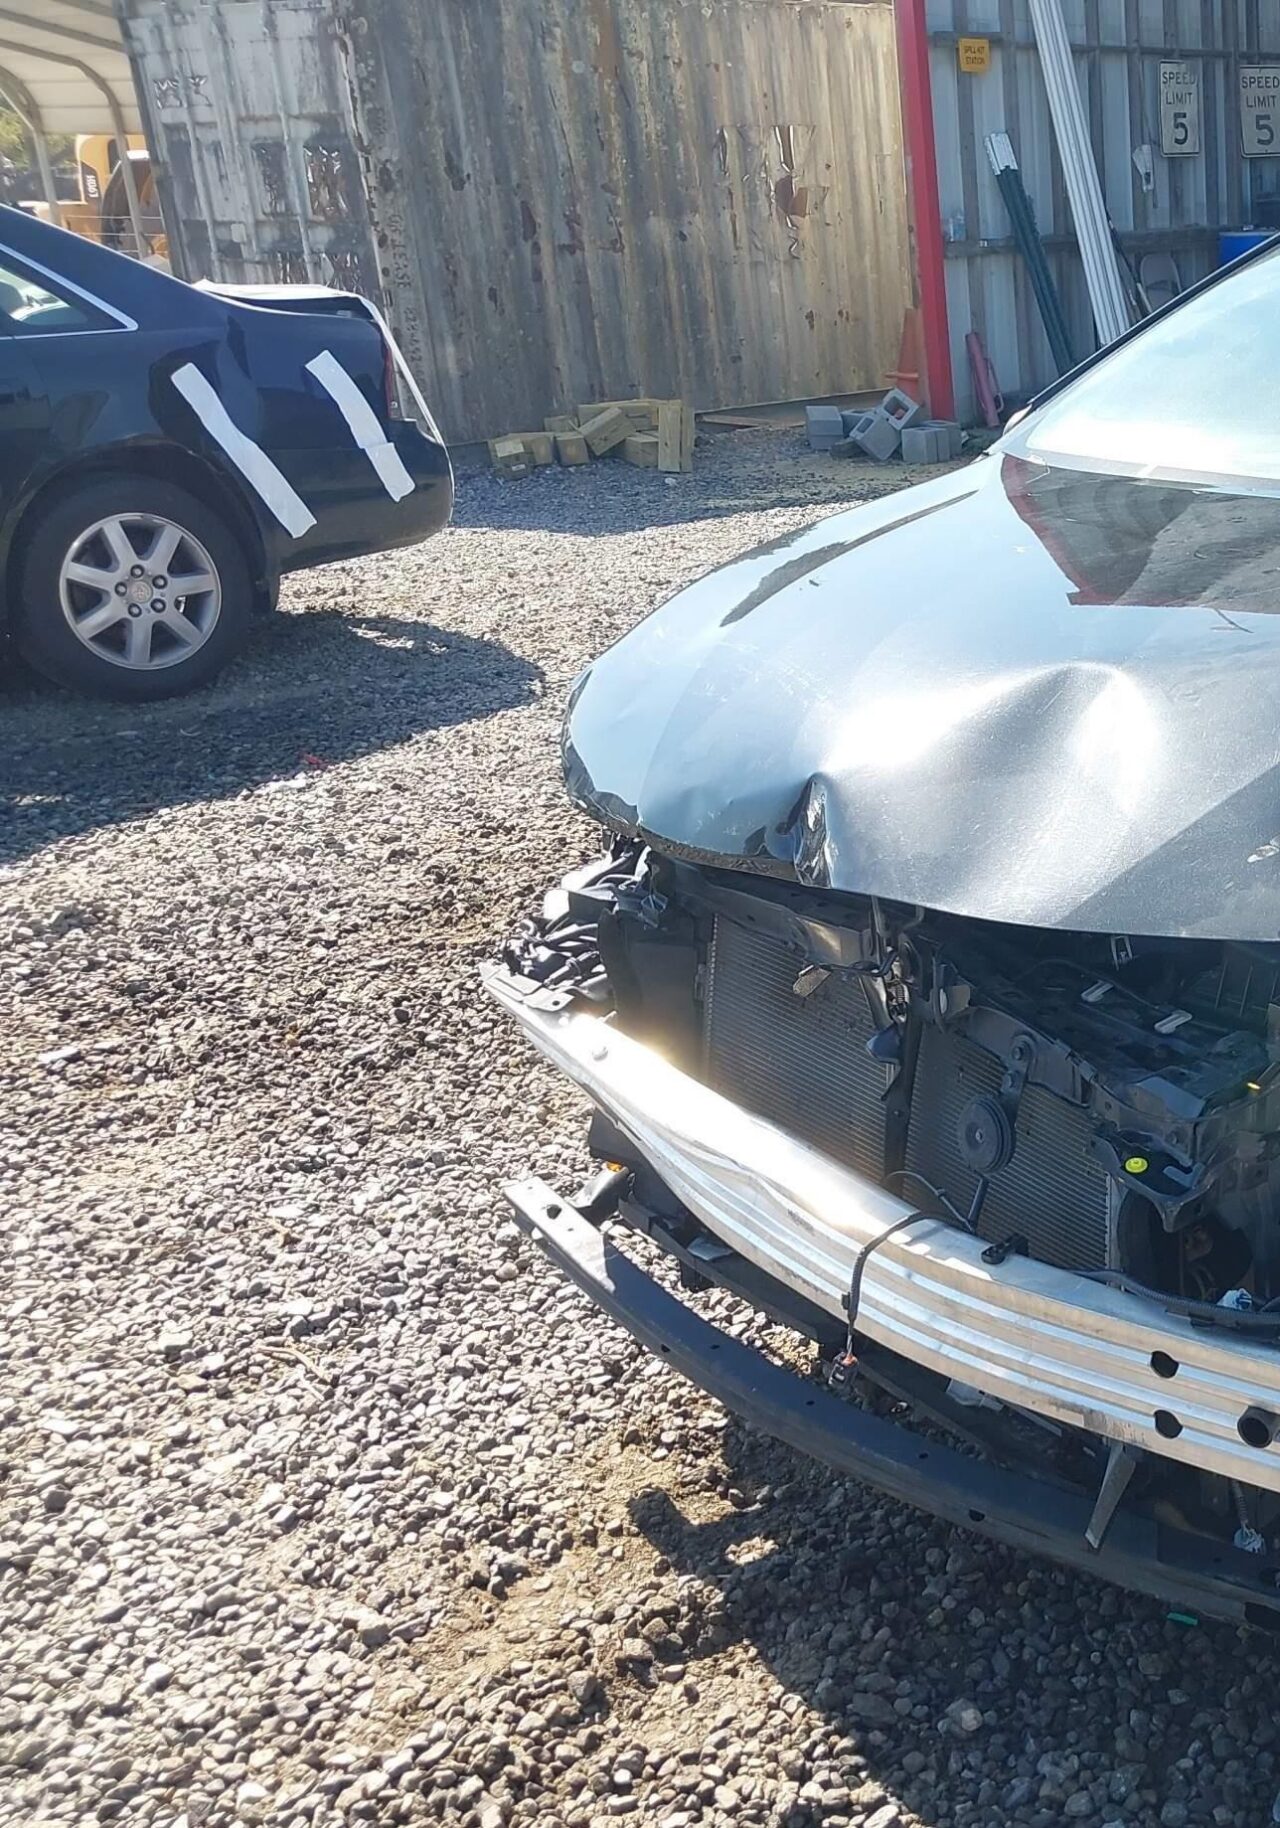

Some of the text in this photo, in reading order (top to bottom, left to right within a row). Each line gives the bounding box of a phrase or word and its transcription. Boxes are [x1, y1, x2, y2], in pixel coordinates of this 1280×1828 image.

[1162, 71, 1196, 85] SPEED
[1241, 76, 1280, 89] SPEED
[1165, 92, 1193, 105] LIMIT
[1245, 95, 1277, 109] LIMIT
[1173, 112, 1189, 146] 5
[1255, 114, 1275, 146] 5
